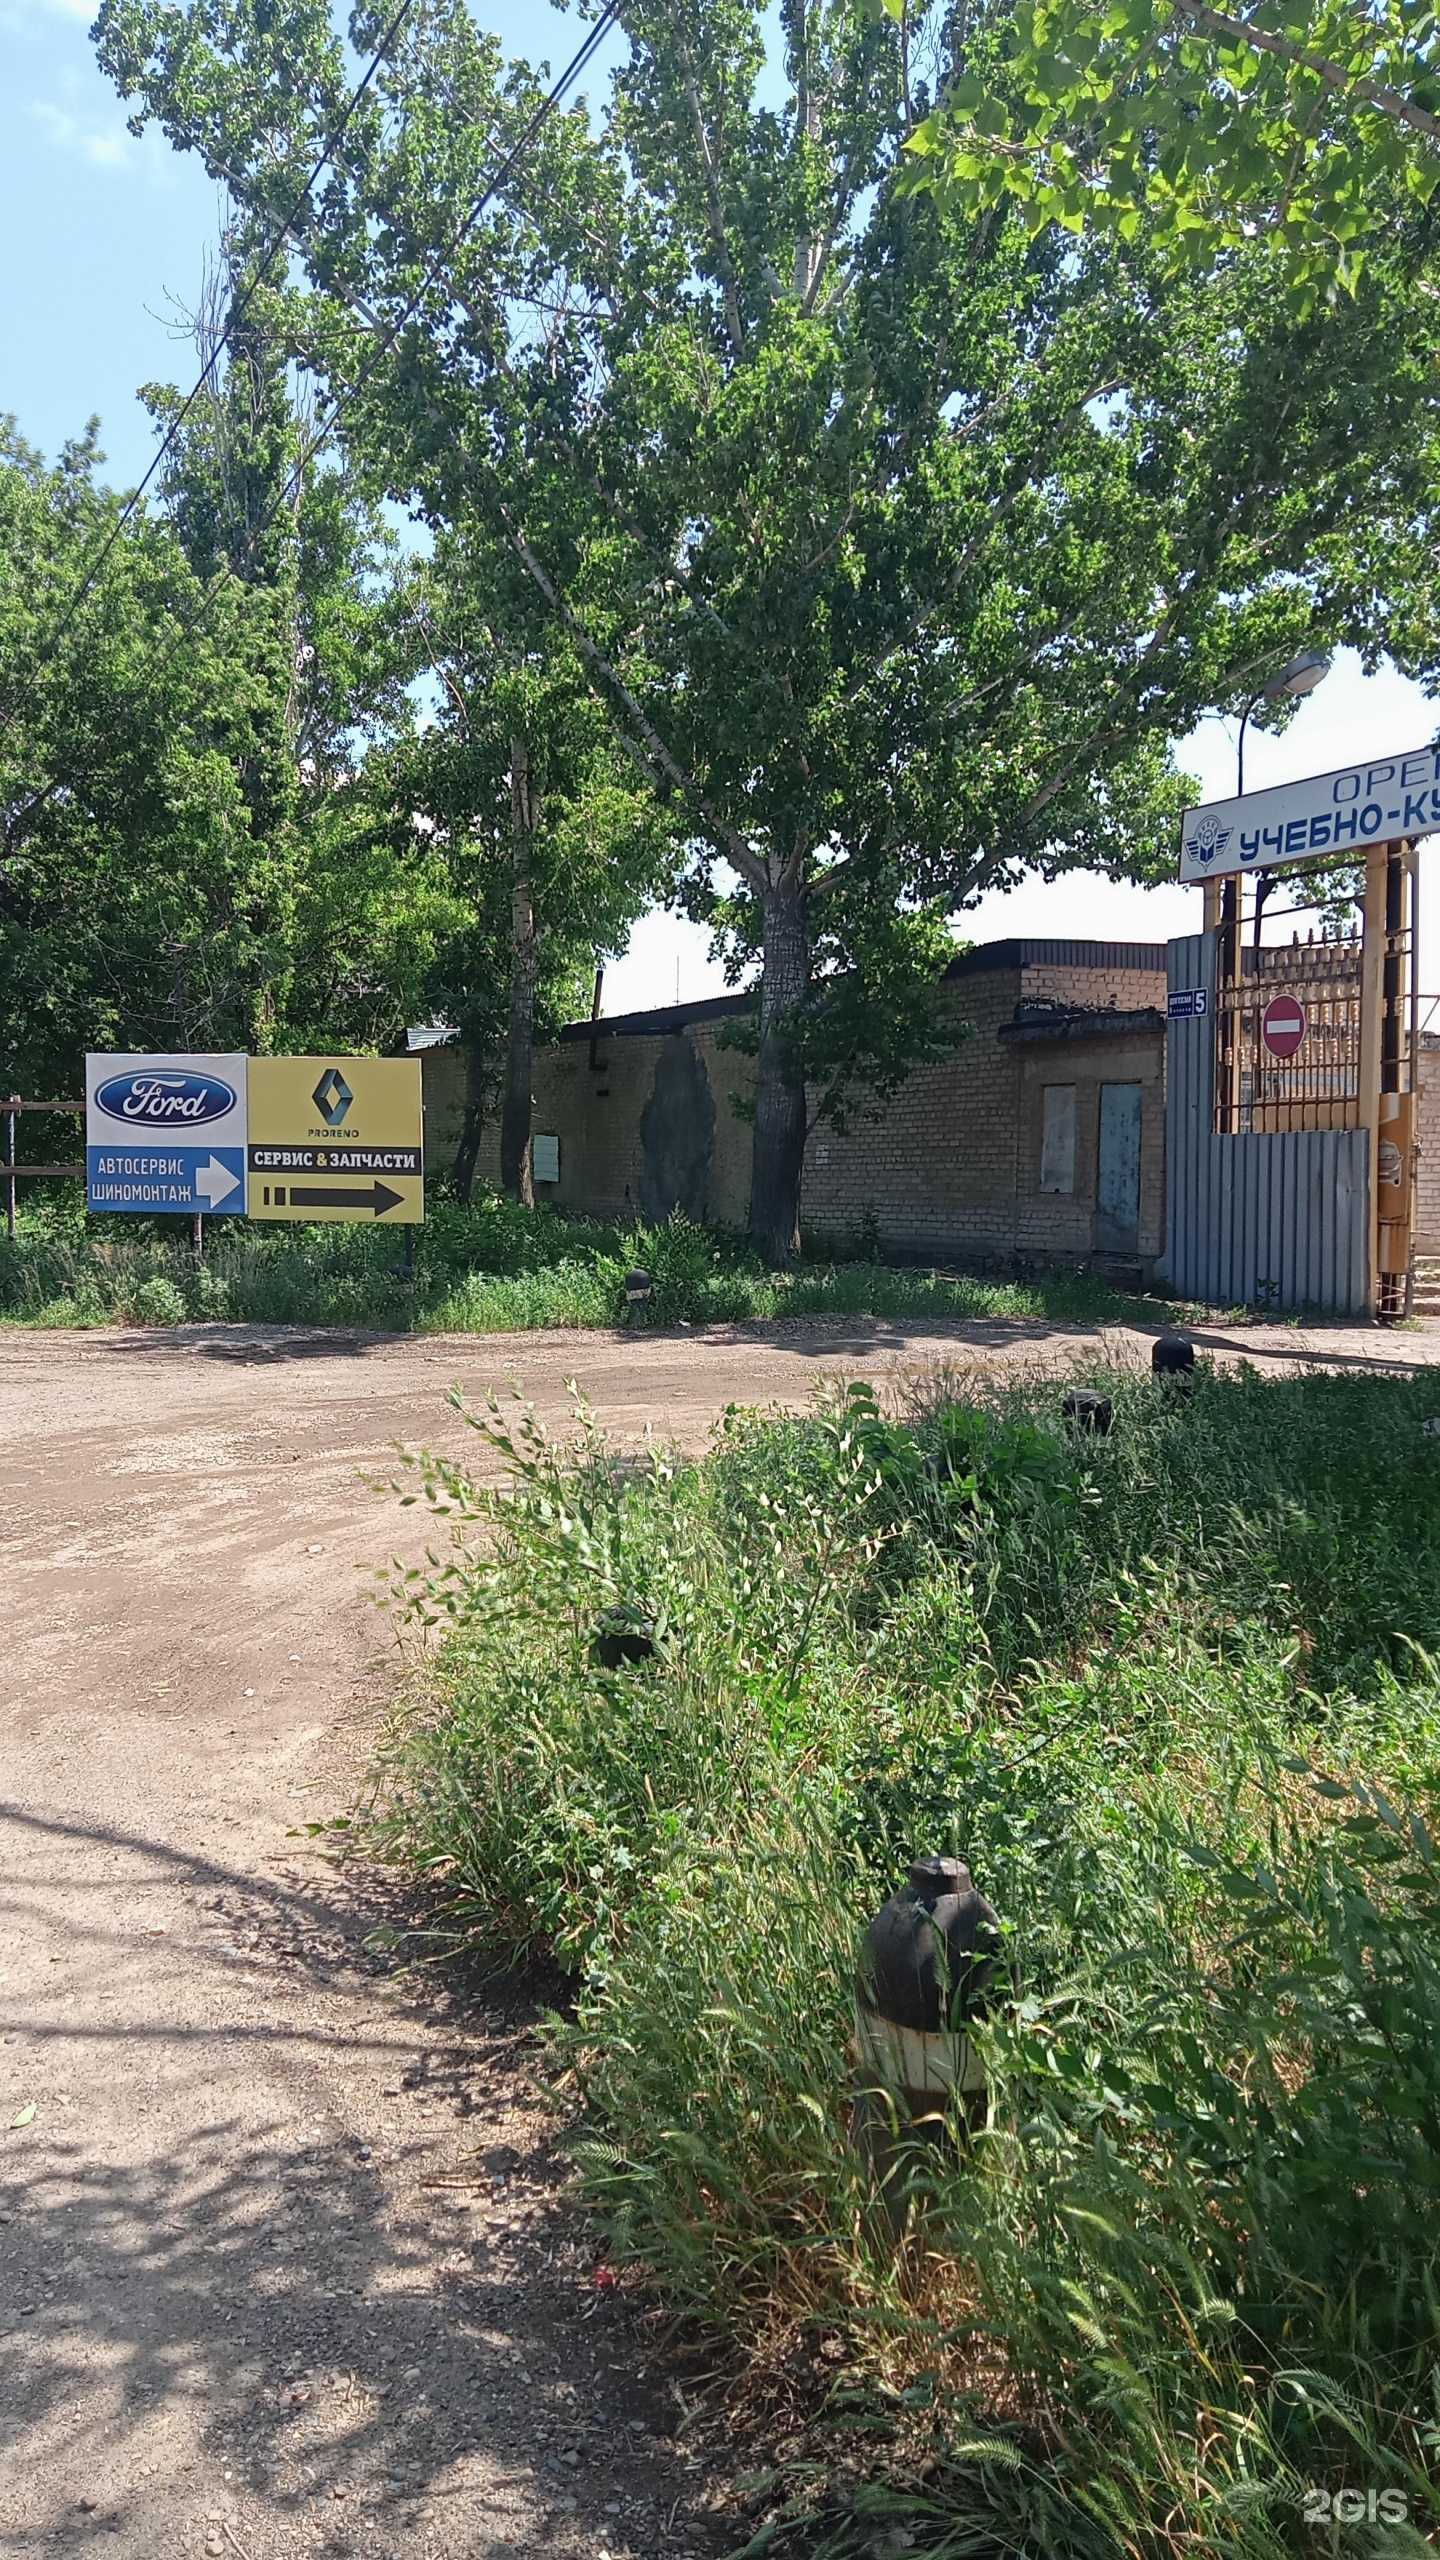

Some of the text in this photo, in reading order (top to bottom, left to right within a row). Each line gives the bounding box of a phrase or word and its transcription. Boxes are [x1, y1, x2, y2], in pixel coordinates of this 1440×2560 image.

[1333, 753, 1440, 804] ОРЕ
[1195, 992, 1205, 1012] 5
[122, 1078, 208, 1116] Ford
[308, 1129, 360, 1138] PRORENO
[98, 1158, 184, 1175] АВТОСЕРВИС
[254, 1151, 415, 1168] СЕРВИС & ЗАПЧАСТИ
[92, 1184, 192, 1202] ШИНОМОНТАЖ
